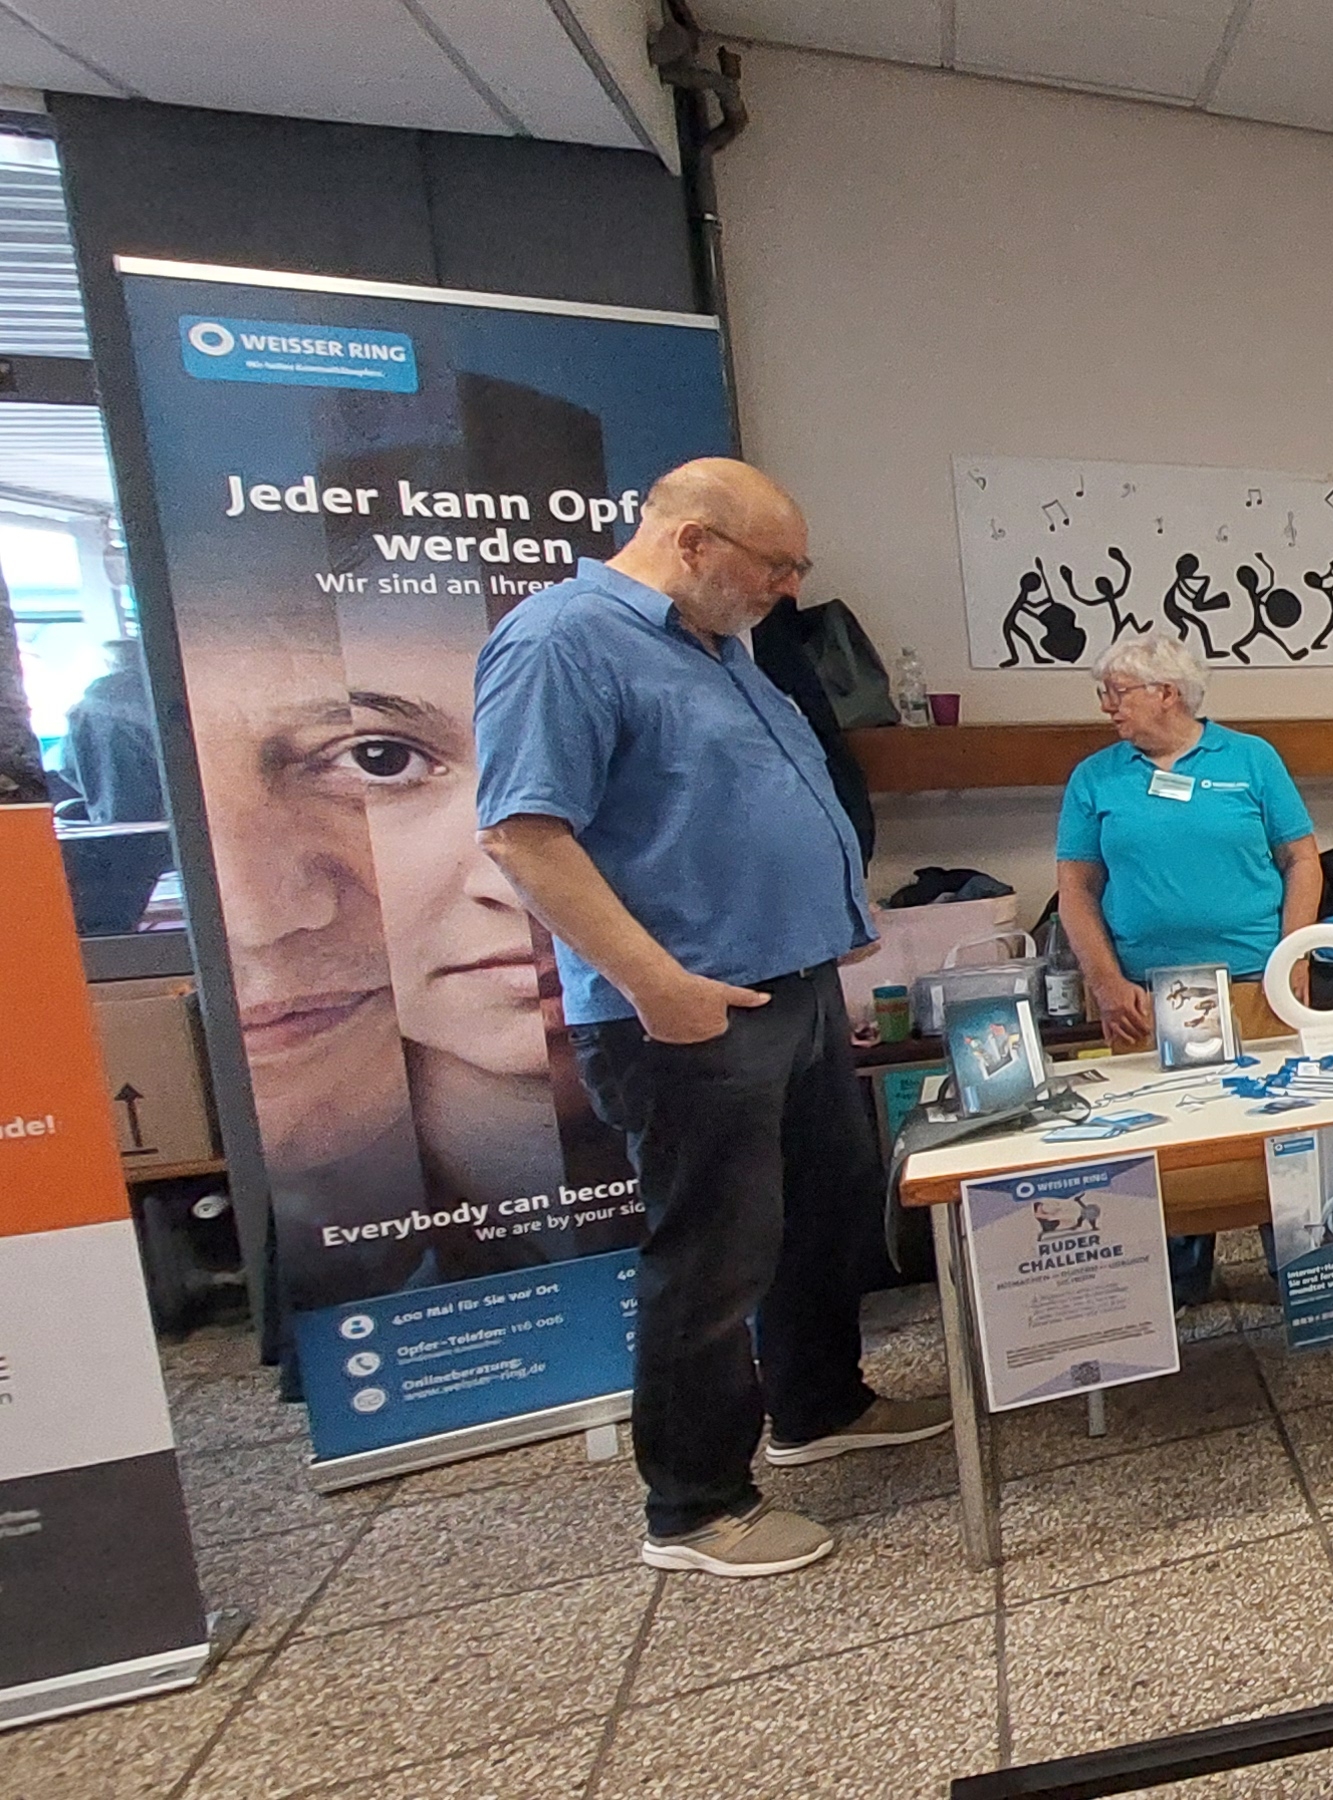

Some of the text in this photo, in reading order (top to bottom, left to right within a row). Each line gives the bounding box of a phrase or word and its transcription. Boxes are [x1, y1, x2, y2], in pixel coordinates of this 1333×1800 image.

[240, 333, 406, 362] WEISSER RING
[226, 474, 646, 532] Jeder kann Opf
[373, 528, 574, 565] werden
[315, 572, 554, 596] Wir sind an Ihrer
[0, 1114, 56, 1139] de!
[1083, 1172, 1109, 1186] RING
[322, 1178, 639, 1247] Everybody can beco
[475, 1200, 646, 1242] We are by your sid
[1018, 1244, 1124, 1275] CHALLENGE
[1038, 1234, 1101, 1257] RUDER
[426, 1304, 454, 1319] Mal
[458, 1299, 480, 1312] für
[483, 1292, 505, 1306] Sie
[508, 1289, 533, 1302] vor
[535, 1282, 560, 1297] Ort
